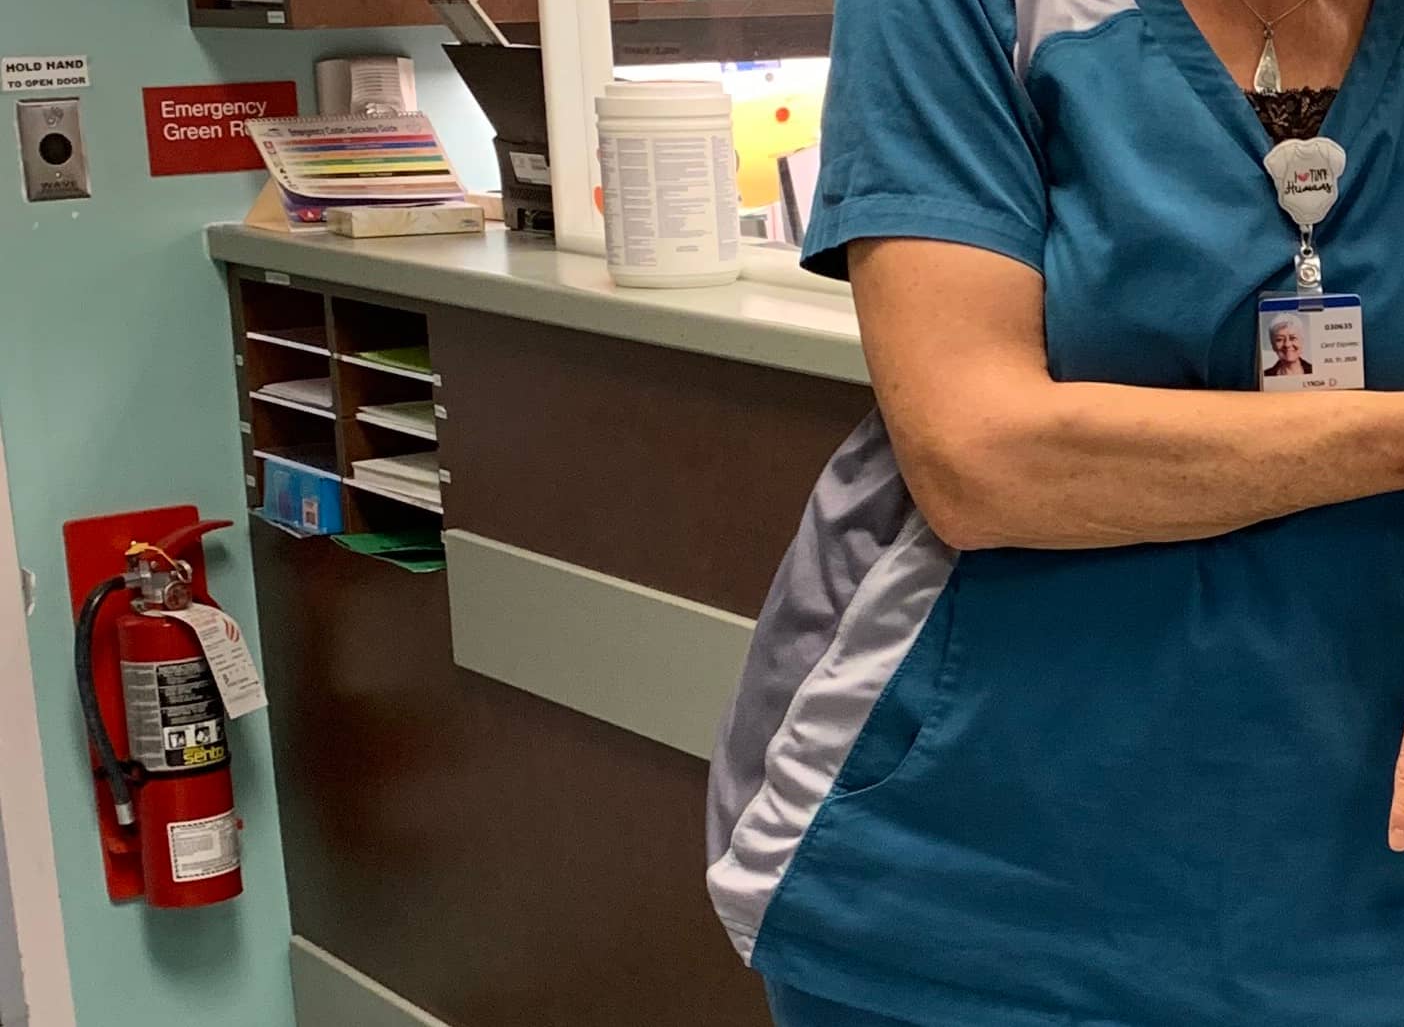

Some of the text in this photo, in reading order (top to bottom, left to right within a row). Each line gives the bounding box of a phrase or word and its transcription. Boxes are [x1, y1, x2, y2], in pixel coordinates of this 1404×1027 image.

[6, 59, 84, 73] HOLD HAND
[8, 76, 86, 88] TO OPEN DOOR
[160, 99, 267, 120] Emergency
[162, 122, 222, 141] Green
